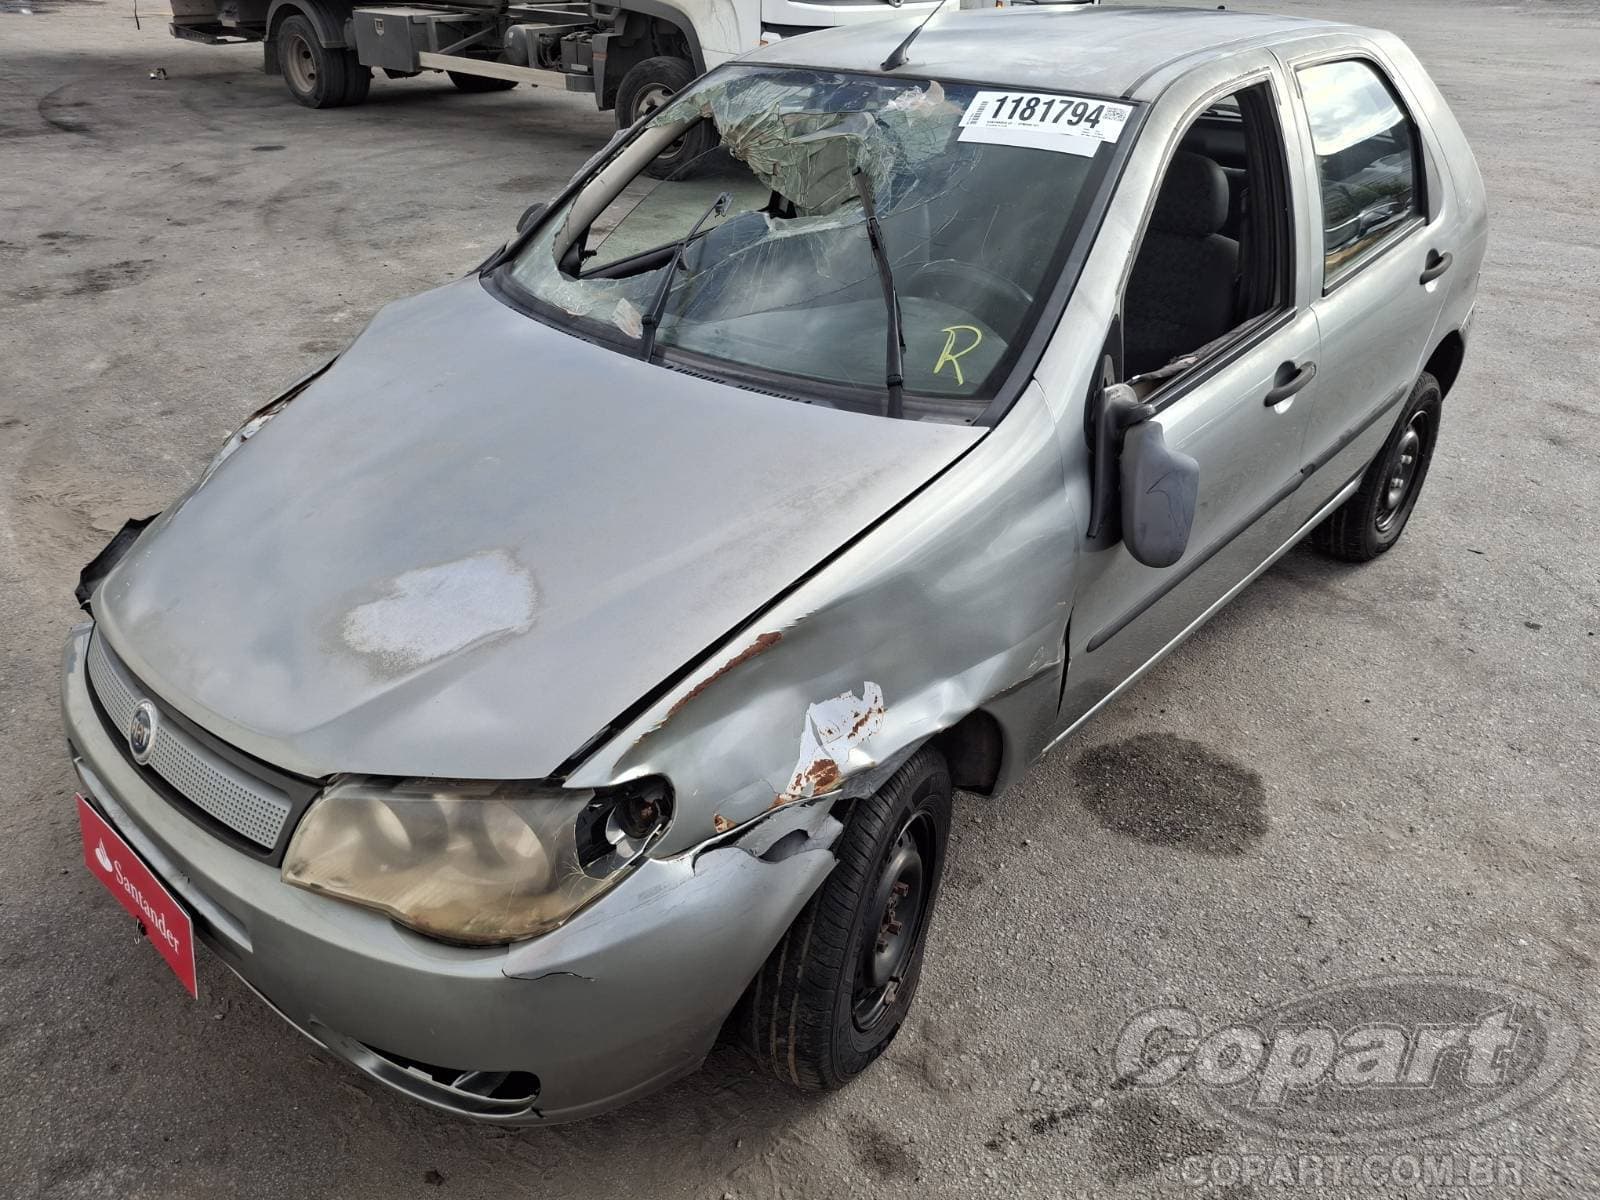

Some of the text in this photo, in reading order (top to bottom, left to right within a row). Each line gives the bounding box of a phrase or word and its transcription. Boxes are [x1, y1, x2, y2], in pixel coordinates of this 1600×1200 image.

[992, 95, 1106, 129] 1181794
[933, 325, 982, 386] R
[114, 860, 180, 955] Santander
